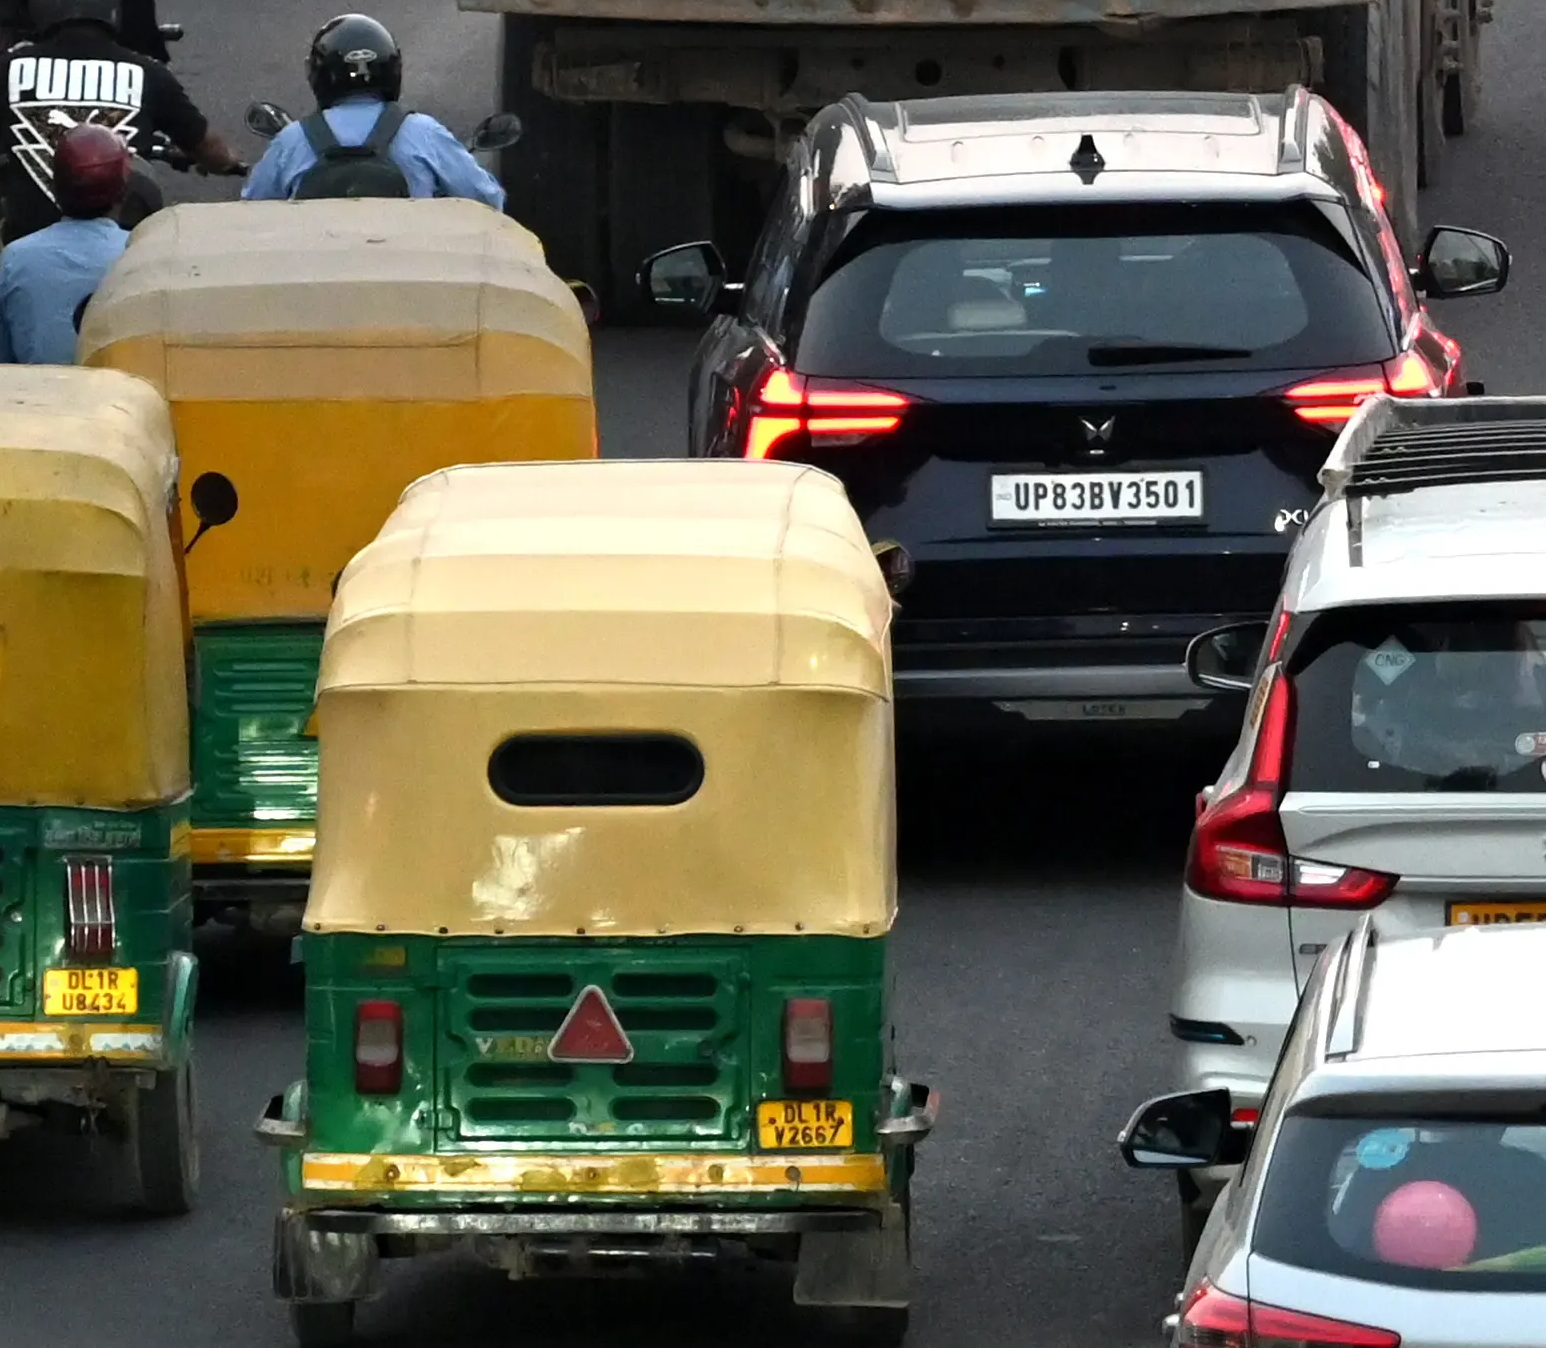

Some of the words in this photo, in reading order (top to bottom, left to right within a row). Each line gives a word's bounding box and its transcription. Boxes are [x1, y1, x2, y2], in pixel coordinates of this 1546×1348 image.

[8, 58, 145, 105] PUMA
[1013, 479, 1196, 511] UP83BV3501
[1374, 652, 1406, 667] CNG
[68, 970, 90, 989] DL
[97, 970, 119, 989] 1R
[62, 992, 127, 1014] U8434
[784, 1103, 808, 1123] DL
[811, 1102, 838, 1121] 1R
[773, 1123, 841, 1146] V2667
